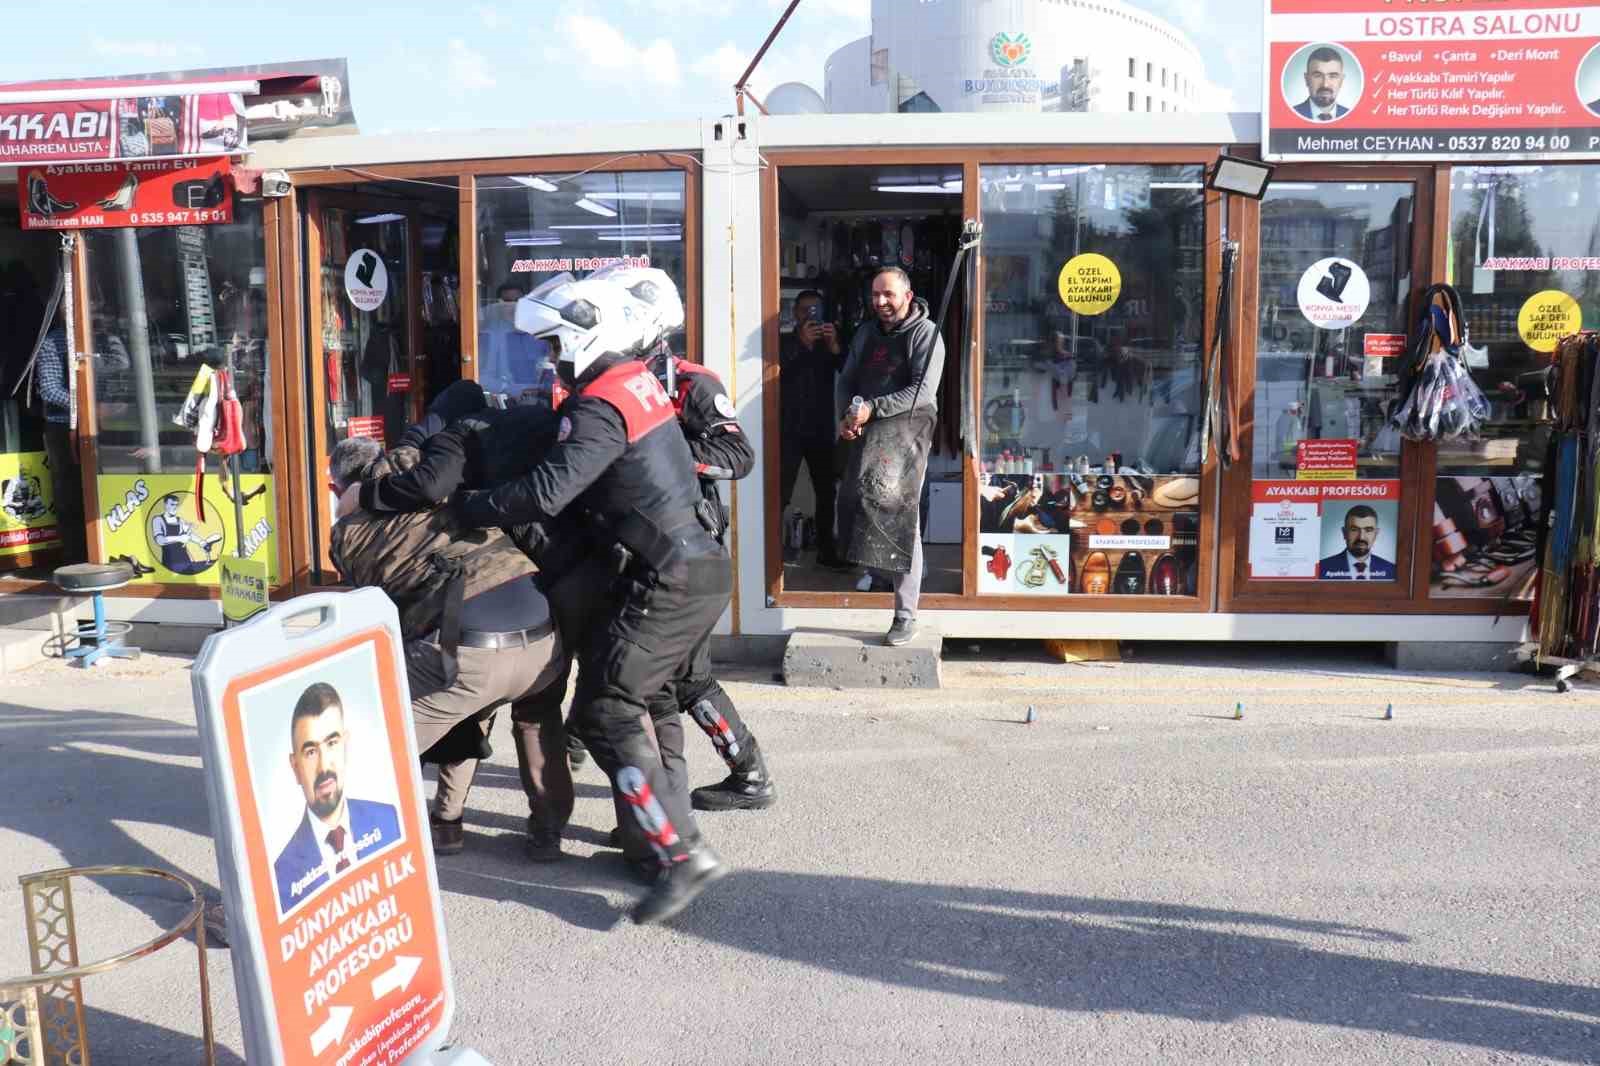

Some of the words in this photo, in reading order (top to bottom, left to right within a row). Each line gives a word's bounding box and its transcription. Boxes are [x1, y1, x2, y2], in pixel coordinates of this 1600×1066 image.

[1365, 16, 1465, 36] LOSTRA
[1473, 13, 1581, 35] SALONU
[1388, 51, 1422, 62] Bavul
[1441, 51, 1477, 64] Çanta
[1497, 49, 1522, 60] Deri
[1525, 49, 1560, 60] Mont
[1388, 72, 1440, 85] Ayakkabı
[1441, 71, 1477, 83] Tamiri
[1388, 88, 1408, 99] Her
[1411, 88, 1438, 99] Türlü
[1388, 104, 1408, 115] Her
[1410, 104, 1438, 115] Türlü
[1440, 104, 1469, 115] Renk
[1472, 104, 1522, 117] Değişimi
[0, 144, 67, 156] UHARREM
[70, 142, 104, 153] USTA
[1298, 136, 1359, 150] Mehmet
[1363, 136, 1434, 150] CEYHAN
[1449, 135, 1487, 150] 0537
[1492, 135, 1520, 150] 820
[1525, 135, 1545, 149] 94
[1550, 135, 1569, 149] 00
[46, 163, 117, 176] Ayakkabı
[123, 160, 168, 171] Tamir
[174, 158, 197, 169] Evi
[29, 216, 79, 228] Muharrem
[80, 215, 105, 226] HAN
[130, 214, 138, 224] 0
[141, 213, 164, 224] 535
[168, 212, 189, 222] 947
[194, 211, 208, 221] 15
[212, 210, 227, 221] 01
[511, 258, 572, 272] AYAKKABI
[1483, 257, 1549, 270] AYAKKABI
[1067, 294, 1112, 303] BULUNUR
[1266, 486, 1320, 496] AYAKKABI
[1322, 484, 1387, 496] PROFESÖRÜ
[104, 479, 150, 532] KLAS
[280, 872, 380, 962] DÜNYANIN
[384, 852, 416, 888] İLK
[309, 894, 398, 977] AYAKKABI
[304, 912, 413, 1015] PROFESÖRÜ
